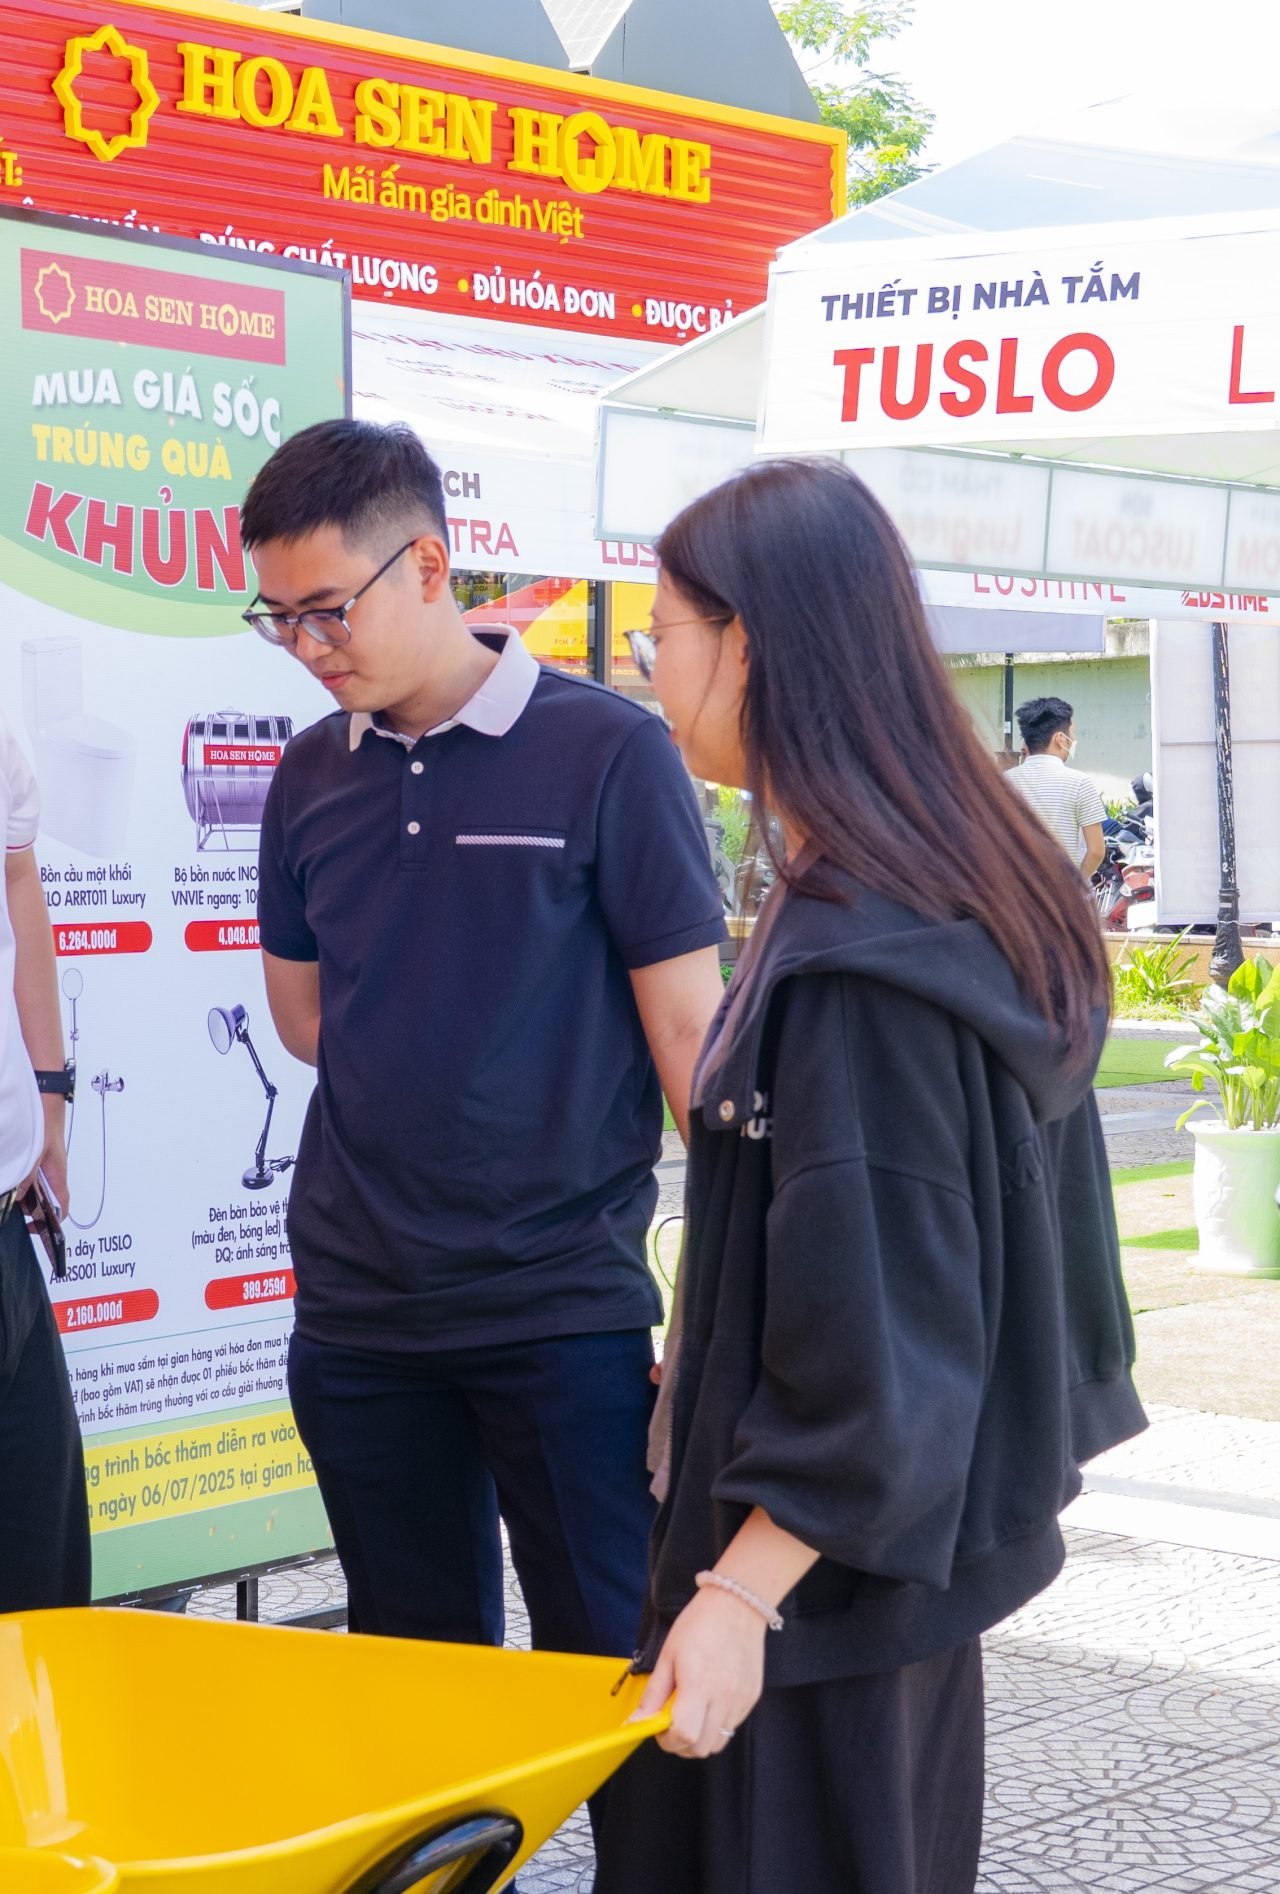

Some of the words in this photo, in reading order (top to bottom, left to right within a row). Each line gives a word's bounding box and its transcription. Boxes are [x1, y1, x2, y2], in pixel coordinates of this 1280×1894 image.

[176, 42, 344, 137] HOA
[355, 77, 498, 165] SEN
[508, 107, 711, 204] HOME
[323, 163, 374, 203] Mái
[380, 163, 429, 210] ấm
[431, 183, 472, 223] gia
[475, 190, 531, 231] đình
[532, 198, 584, 245] Việt
[352, 254, 438, 297] LƯỢNG
[472, 264, 506, 303] ĐỦ
[511, 270, 560, 312] HÓA
[563, 284, 615, 320] ĐƠN
[645, 298, 707, 338] ĐƯỢC
[709, 298, 736, 332] BẢ
[820, 278, 918, 321] THIẾT
[927, 285, 962, 320] BỊ
[973, 270, 1050, 311] NHÀ
[1062, 261, 1140, 304] TẮM
[84, 285, 139, 319] HOA
[145, 295, 193, 326] SEN
[200, 304, 275, 339] HOME
[832, 332, 1115, 423] TUSLO
[32, 368, 121, 406] MUA
[133, 366, 202, 420] GIÁ
[213, 375, 280, 449] SỐC
[32, 421, 151, 471] TRÚNG
[161, 438, 232, 480] QUÀ
[443, 470, 481, 499] CH
[24, 480, 258, 593] KHỦN
[210, 750, 229, 760] HOA
[230, 750, 246, 760] SEN
[248, 750, 275, 761] HOME
[40, 864, 61, 882] Bồn
[64, 864, 83, 882] cầu
[86, 866, 106, 885] một
[109, 862, 132, 881] khối
[174, 867, 187, 886] Bộ
[191, 864, 209, 882] bồn
[238, 866, 259, 881] INO
[65, 889, 107, 906] ARRT011
[112, 889, 146, 909] Luxury
[171, 890, 204, 906] VNVIE
[207, 893, 241, 910] ngang:
[59, 929, 117, 951] 6.264.000đ
[218, 926, 261, 945] 4.048.00
[209, 1207, 228, 1222] Đèn
[230, 1203, 248, 1220] bàn
[249, 1201, 268, 1218] bảo
[269, 1200, 280, 1218] vệ
[75, 1239, 96, 1259] dây
[98, 1233, 132, 1253] TUSLO
[191, 1230, 215, 1250] (màu
[217, 1225, 237, 1243] đen,
[239, 1223, 263, 1242] bóng
[265, 1219, 281, 1238] led)
[101, 1261, 136, 1278] Luxury
[215, 1246, 234, 1263] ĐQ:
[236, 1242, 254, 1260] ánh
[255, 1243, 277, 1260] sáng
[67, 1299, 123, 1328] 2.160.000đ
[76, 1368, 98, 1382] hàng
[101, 1363, 114, 1377] khi
[116, 1363, 135, 1374] mua
[138, 1355, 155, 1370] sắm
[158, 1353, 168, 1370] tại
[170, 1352, 189, 1368] gian
[192, 1348, 212, 1362] hàng
[229, 1342, 244, 1354] hóa
[264, 1338, 282, 1348] mua
[81, 1388, 100, 1404] (bao
[103, 1382, 122, 1401] gồm
[125, 1379, 144, 1394] VAT)
[146, 1378, 155, 1390] sẽ
[157, 1374, 178, 1389] nhận
[203, 1367, 212, 1380] 01
[215, 1361, 238, 1381] phiếu
[240, 1358, 254, 1374] bốc
[256, 1358, 276, 1371] thăm
[98, 1404, 114, 1420] bốc
[116, 1402, 138, 1417] thăm
[140, 1399, 162, 1413] trúng
[222, 1382, 236, 1397] cấu
[238, 1380, 254, 1398] giải
[105, 1449, 139, 1477] trình
[144, 1441, 171, 1469] bốc
[175, 1440, 212, 1463] thăm
[216, 1428, 247, 1455] diễn
[252, 1432, 266, 1448] ra
[270, 1423, 296, 1443] vào
[99, 1491, 137, 1521] ngày
[142, 1468, 235, 1507] 06/07/2025
[240, 1463, 258, 1490] tại
[262, 1460, 293, 1487] gian
